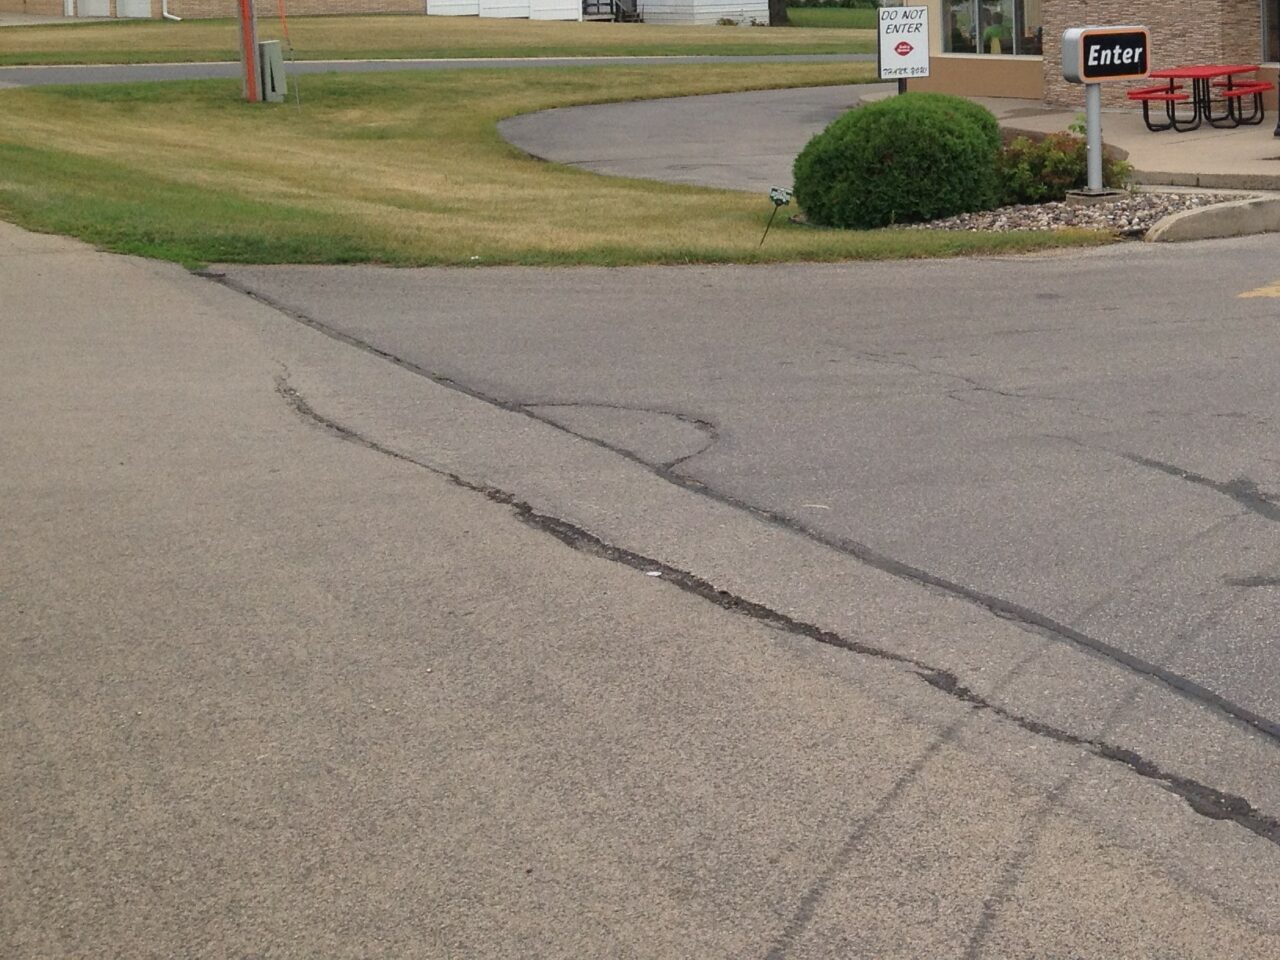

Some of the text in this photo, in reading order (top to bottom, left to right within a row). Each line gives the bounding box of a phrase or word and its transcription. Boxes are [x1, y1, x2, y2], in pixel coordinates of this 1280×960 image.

[881, 9, 926, 21] DO NOT
[885, 22, 923, 34] ENTER
[1088, 44, 1144, 66] Enter
